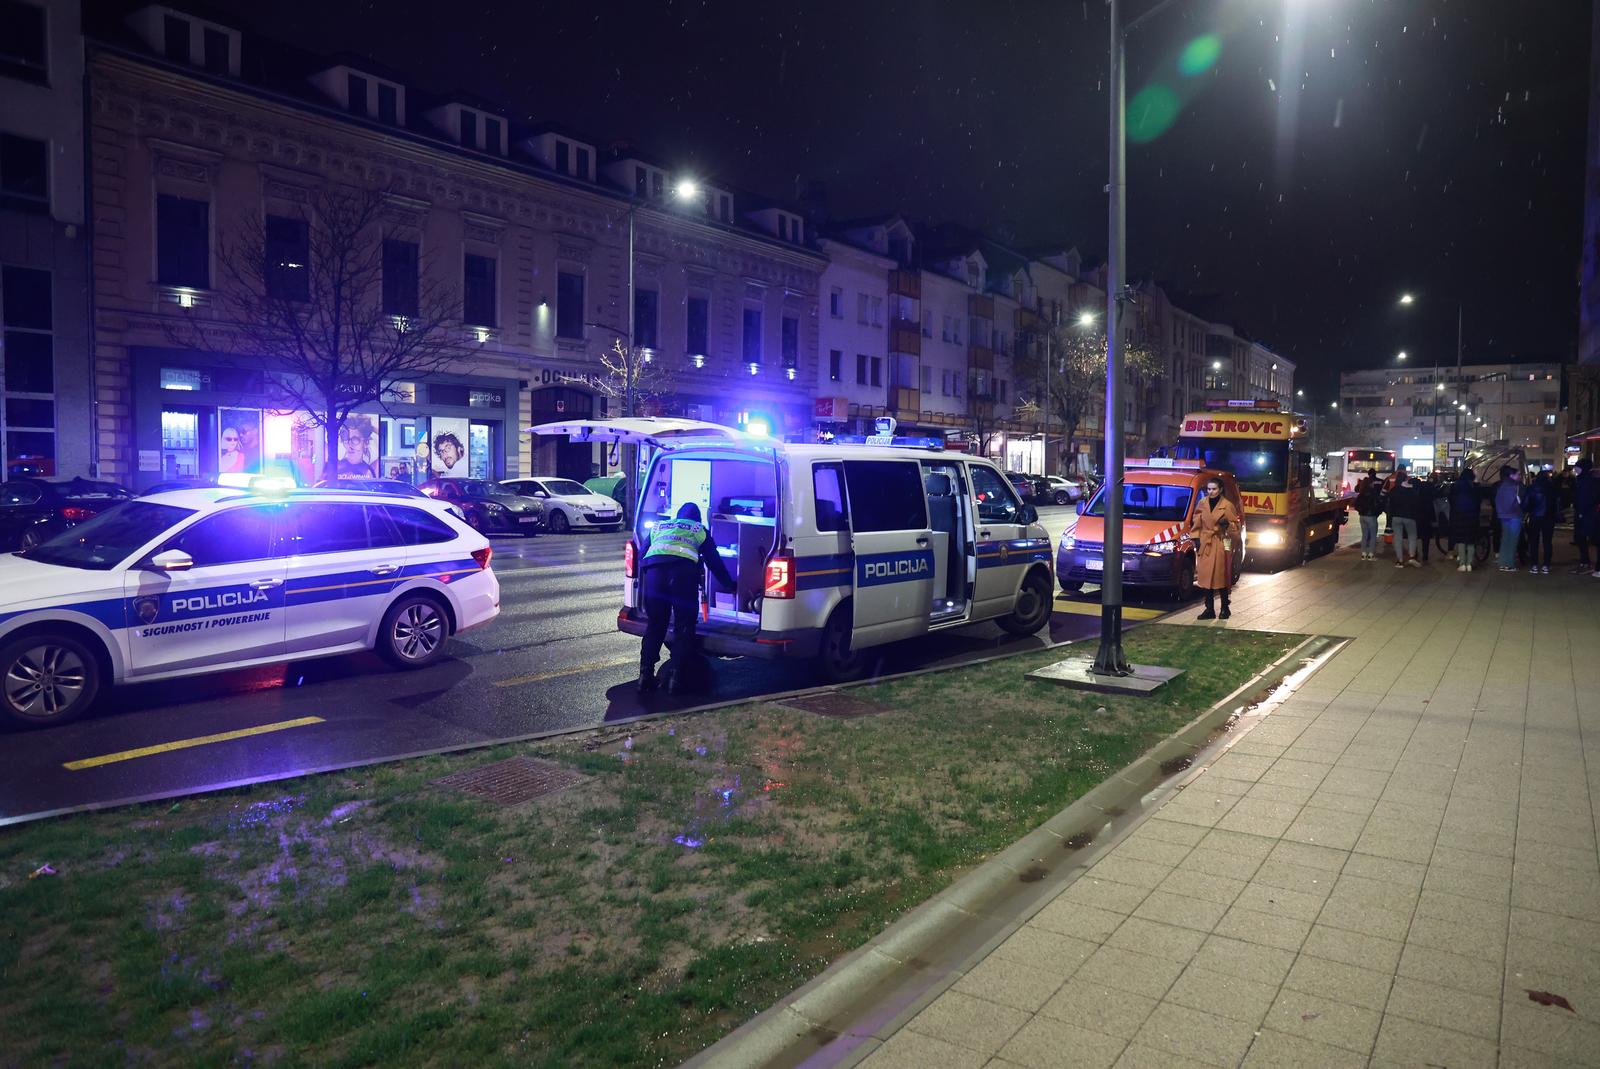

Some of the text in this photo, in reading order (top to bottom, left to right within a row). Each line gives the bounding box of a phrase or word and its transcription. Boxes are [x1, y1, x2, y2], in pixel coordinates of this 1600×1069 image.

[473, 391, 502, 404] optika
[1185, 420, 1283, 434] BISTROVIC
[865, 558, 928, 579] POLICIJA
[172, 589, 269, 613] POLICIJA
[143, 612, 271, 637] SIGURNOST I POVJERENJE
